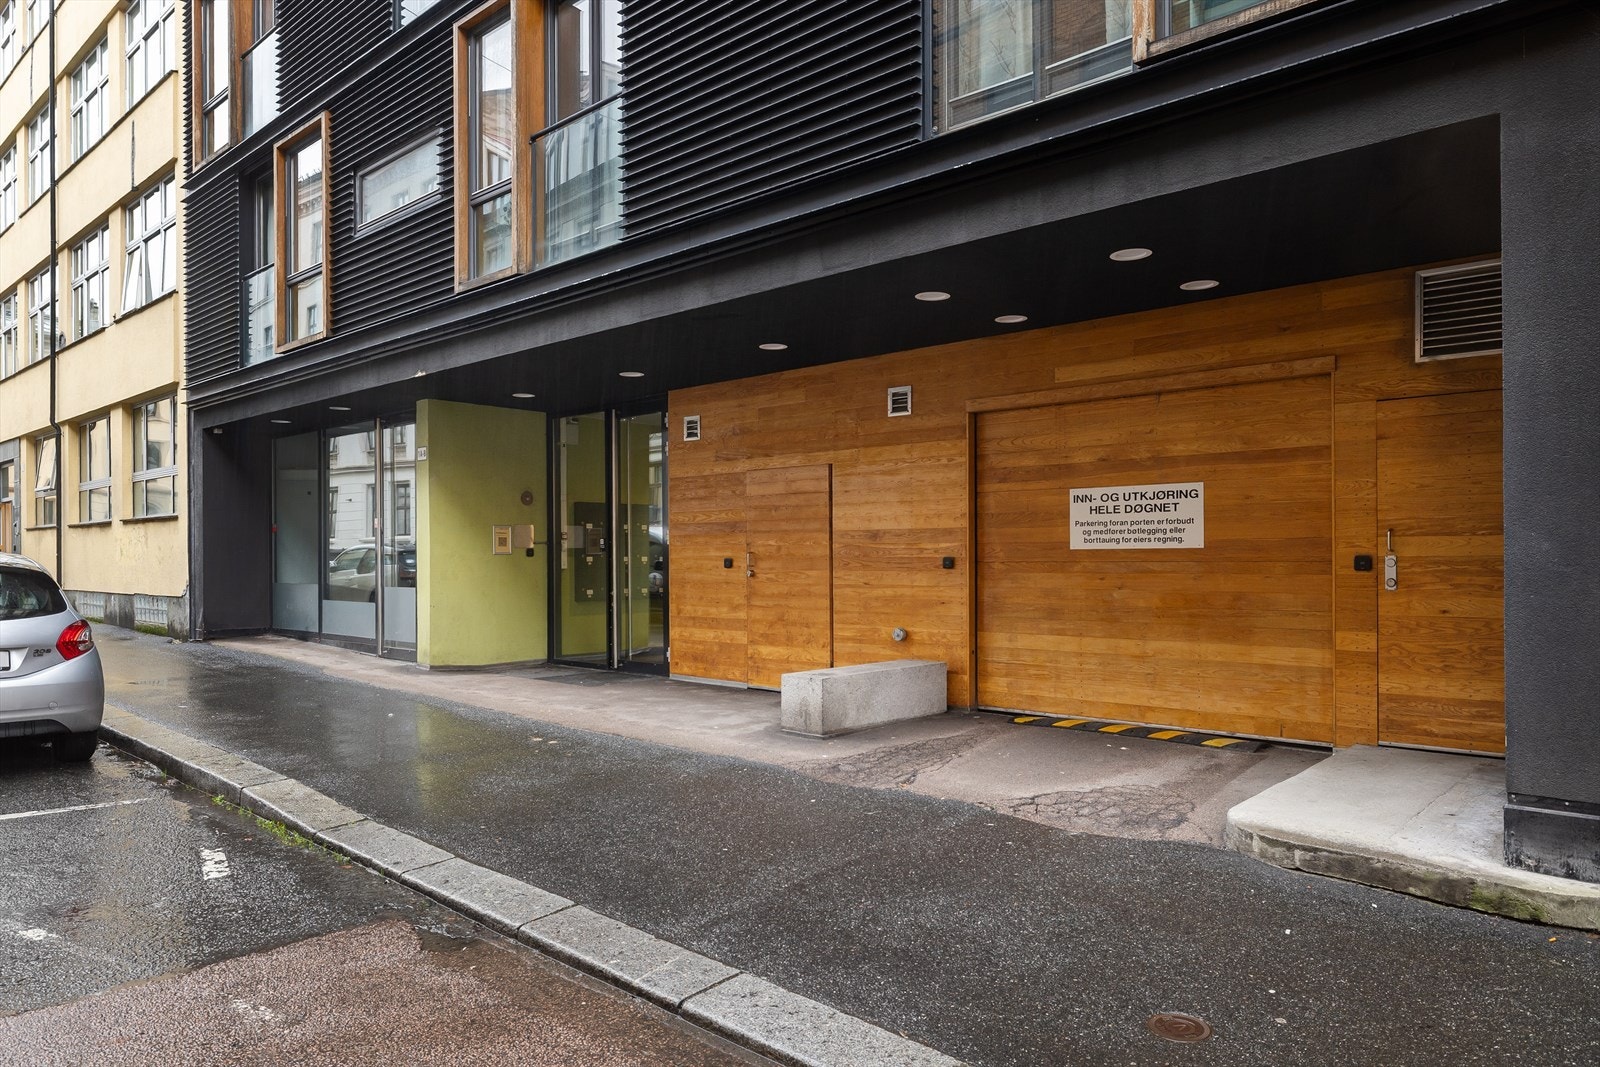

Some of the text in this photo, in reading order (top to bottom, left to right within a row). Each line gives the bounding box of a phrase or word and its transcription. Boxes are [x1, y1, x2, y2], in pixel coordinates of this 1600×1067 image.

[1073, 488, 1198, 504] INN- OG UTKJØRING
[1090, 502, 1180, 514] HELE DØGNET
[1075, 520, 1108, 528] Parkering
[1130, 518, 1155, 527] porten
[1166, 517, 1194, 525] forbudt
[1154, 535, 1184, 544] regning.
